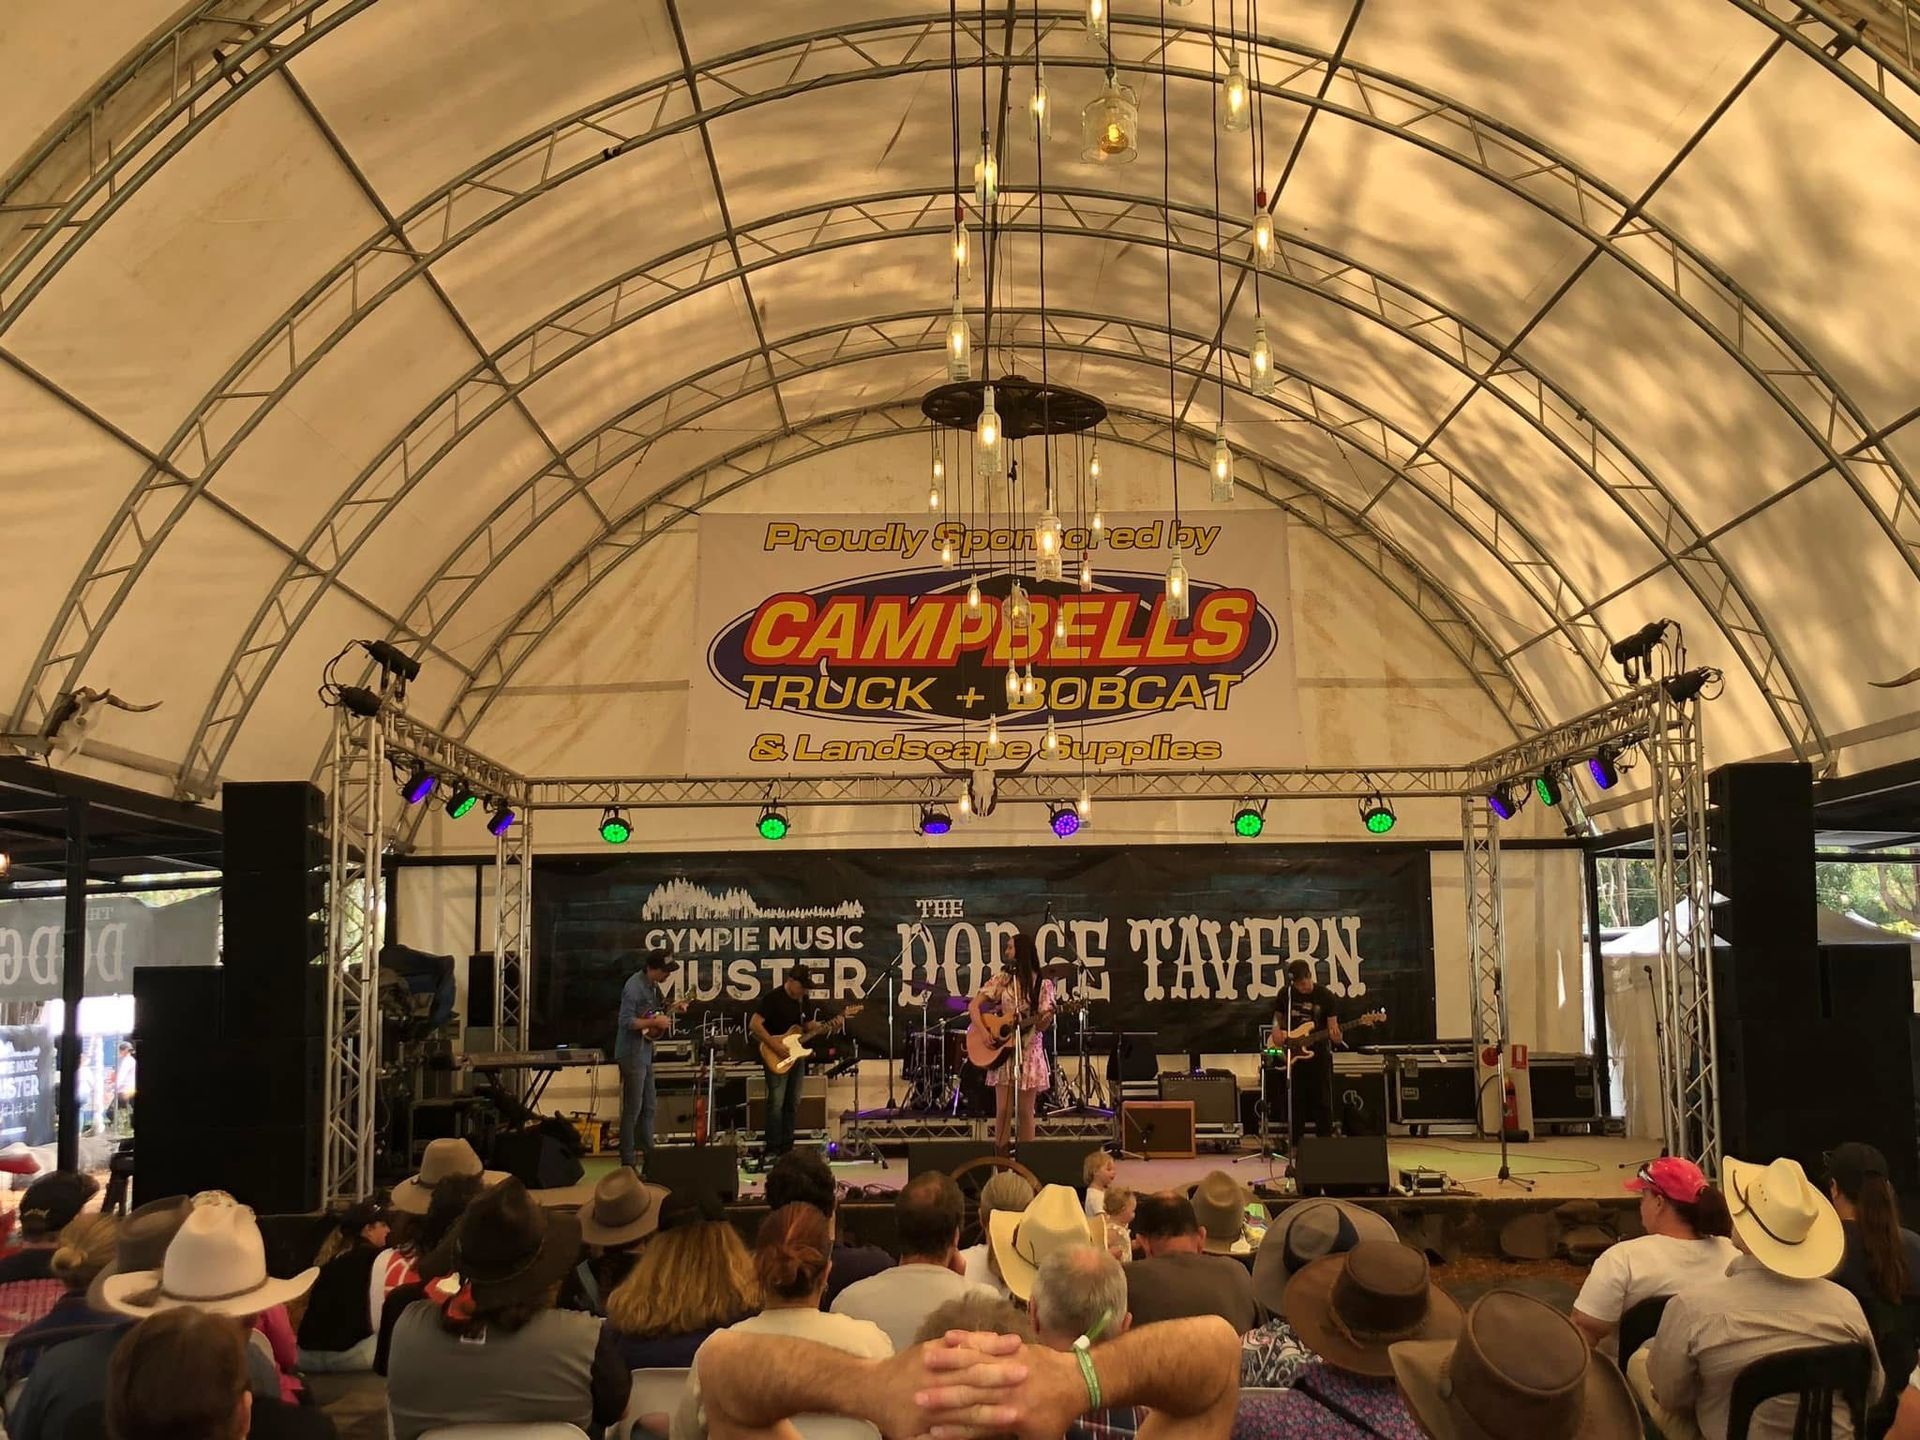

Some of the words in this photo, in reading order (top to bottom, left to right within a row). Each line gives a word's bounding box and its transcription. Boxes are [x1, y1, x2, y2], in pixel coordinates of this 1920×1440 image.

[764, 522, 928, 559] Proudly
[1168, 520, 1221, 555] by
[747, 593, 1253, 664] CAMPBELLS
[742, 674, 938, 710] TRUCK
[956, 686, 984, 709] +
[1006, 673, 1243, 711] BOBCAT
[750, 734, 788, 761] &
[793, 734, 1031, 766] Landscape
[1039, 734, 1222, 765] Supplies
[915, 899, 963, 918] THE
[645, 927, 760, 952] GYMPIE
[769, 925, 864, 950] MUSIC
[1126, 914, 1366, 1001] TAVERN
[0, 1074, 40, 1099] USTER
